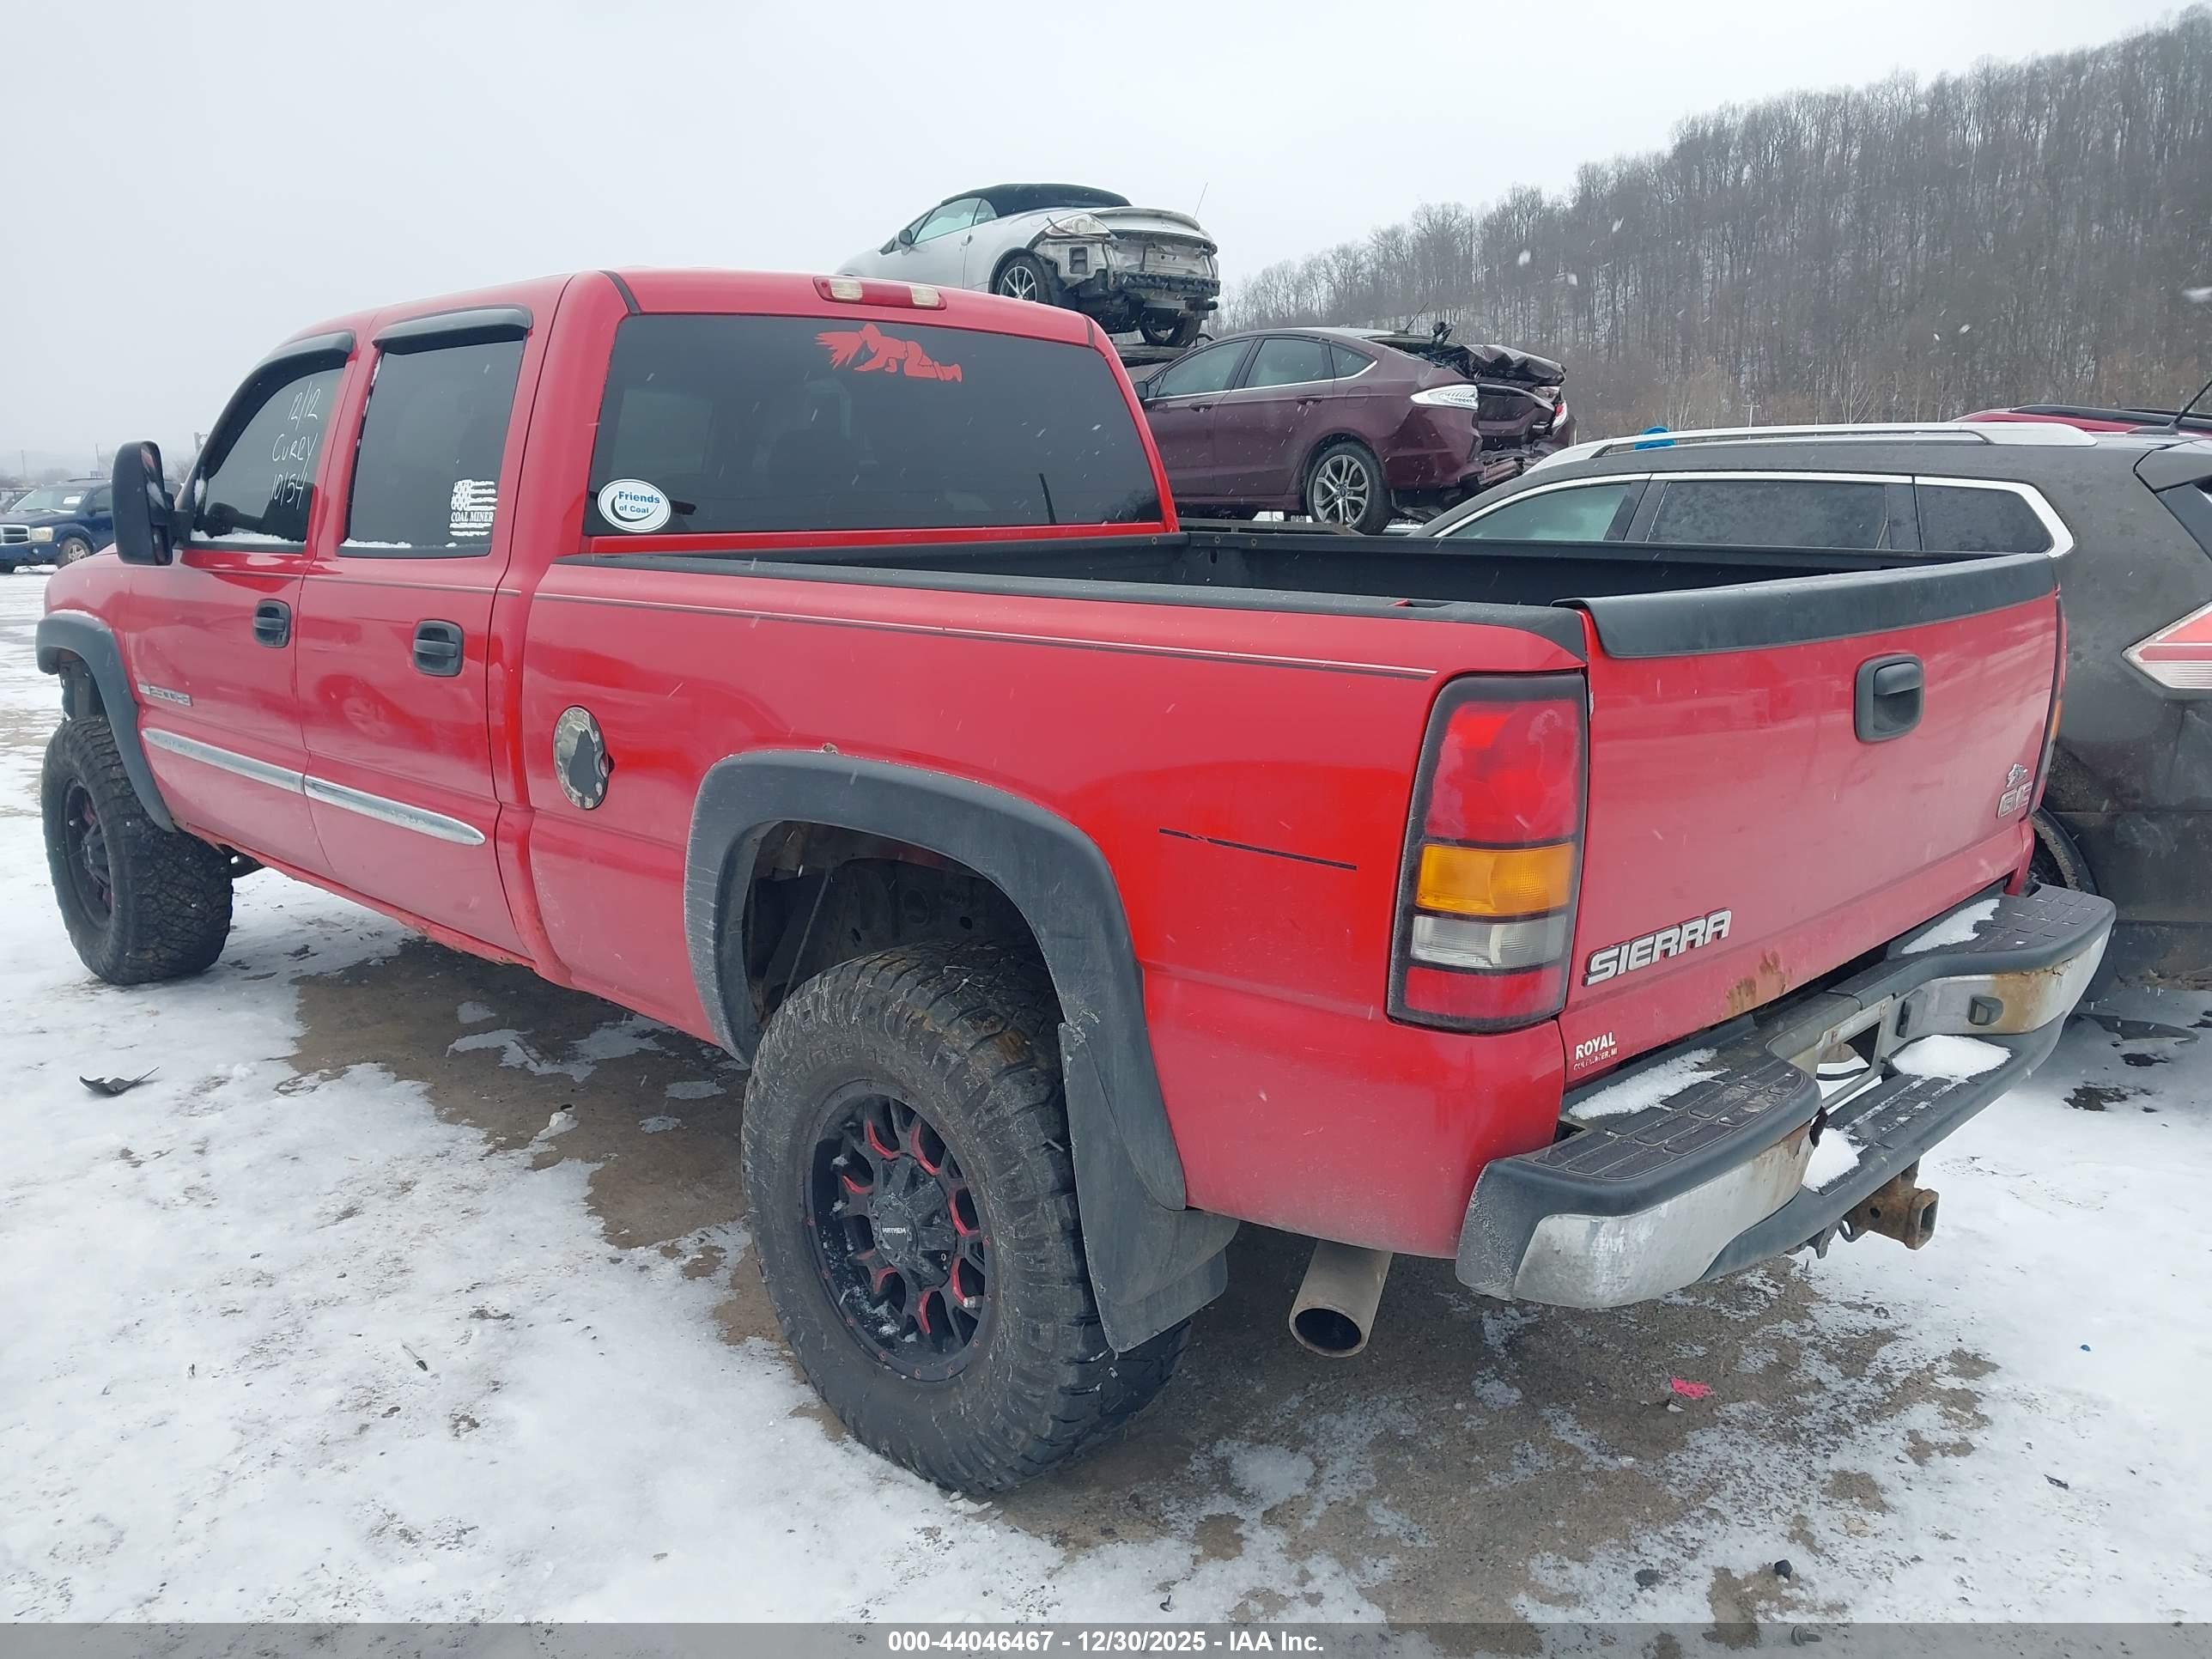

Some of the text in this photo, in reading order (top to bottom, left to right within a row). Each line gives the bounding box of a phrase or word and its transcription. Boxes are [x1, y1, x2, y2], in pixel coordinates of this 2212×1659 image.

[288, 380, 321, 431] 12/12
[617, 490, 660, 504] Friends
[450, 511, 495, 522] COAL MINER
[629, 505, 649, 514] Coal
[1583, 908, 1732, 987] SIERRA
[1575, 1031, 1616, 1060] ROYAL
